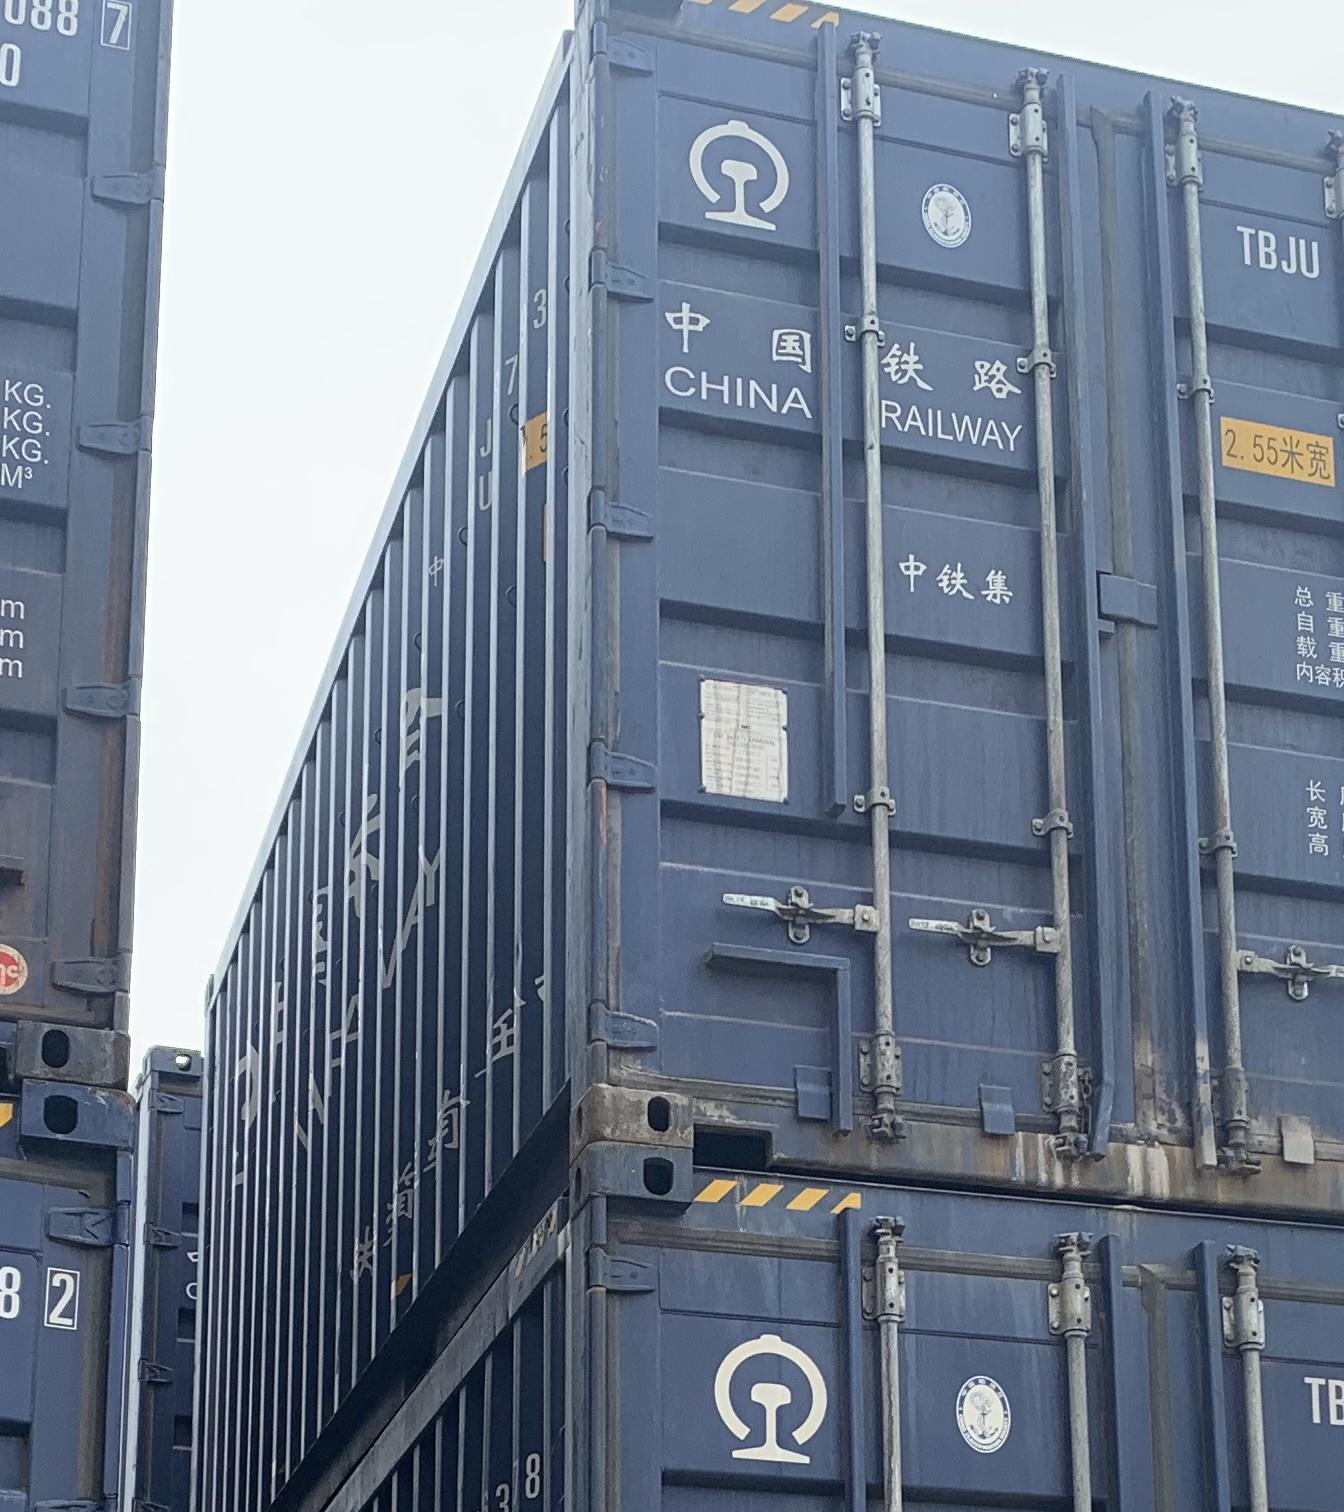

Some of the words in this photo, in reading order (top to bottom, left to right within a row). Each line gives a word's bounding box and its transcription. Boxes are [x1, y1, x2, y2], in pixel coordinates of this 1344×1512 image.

[107, 3, 128, 44] 7
[1236, 225, 1320, 279] TBJU
[4, 379, 51, 409] KG.
[664, 366, 813, 419] CHINA
[881, 399, 1024, 452] RAILWAY
[3, 406, 50, 437] KG.
[2, 434, 49, 465] KG.
[898, 553, 1013, 605] 中铁集
[1294, 585, 1344, 613] 总重
[49, 1273, 74, 1324] 2
